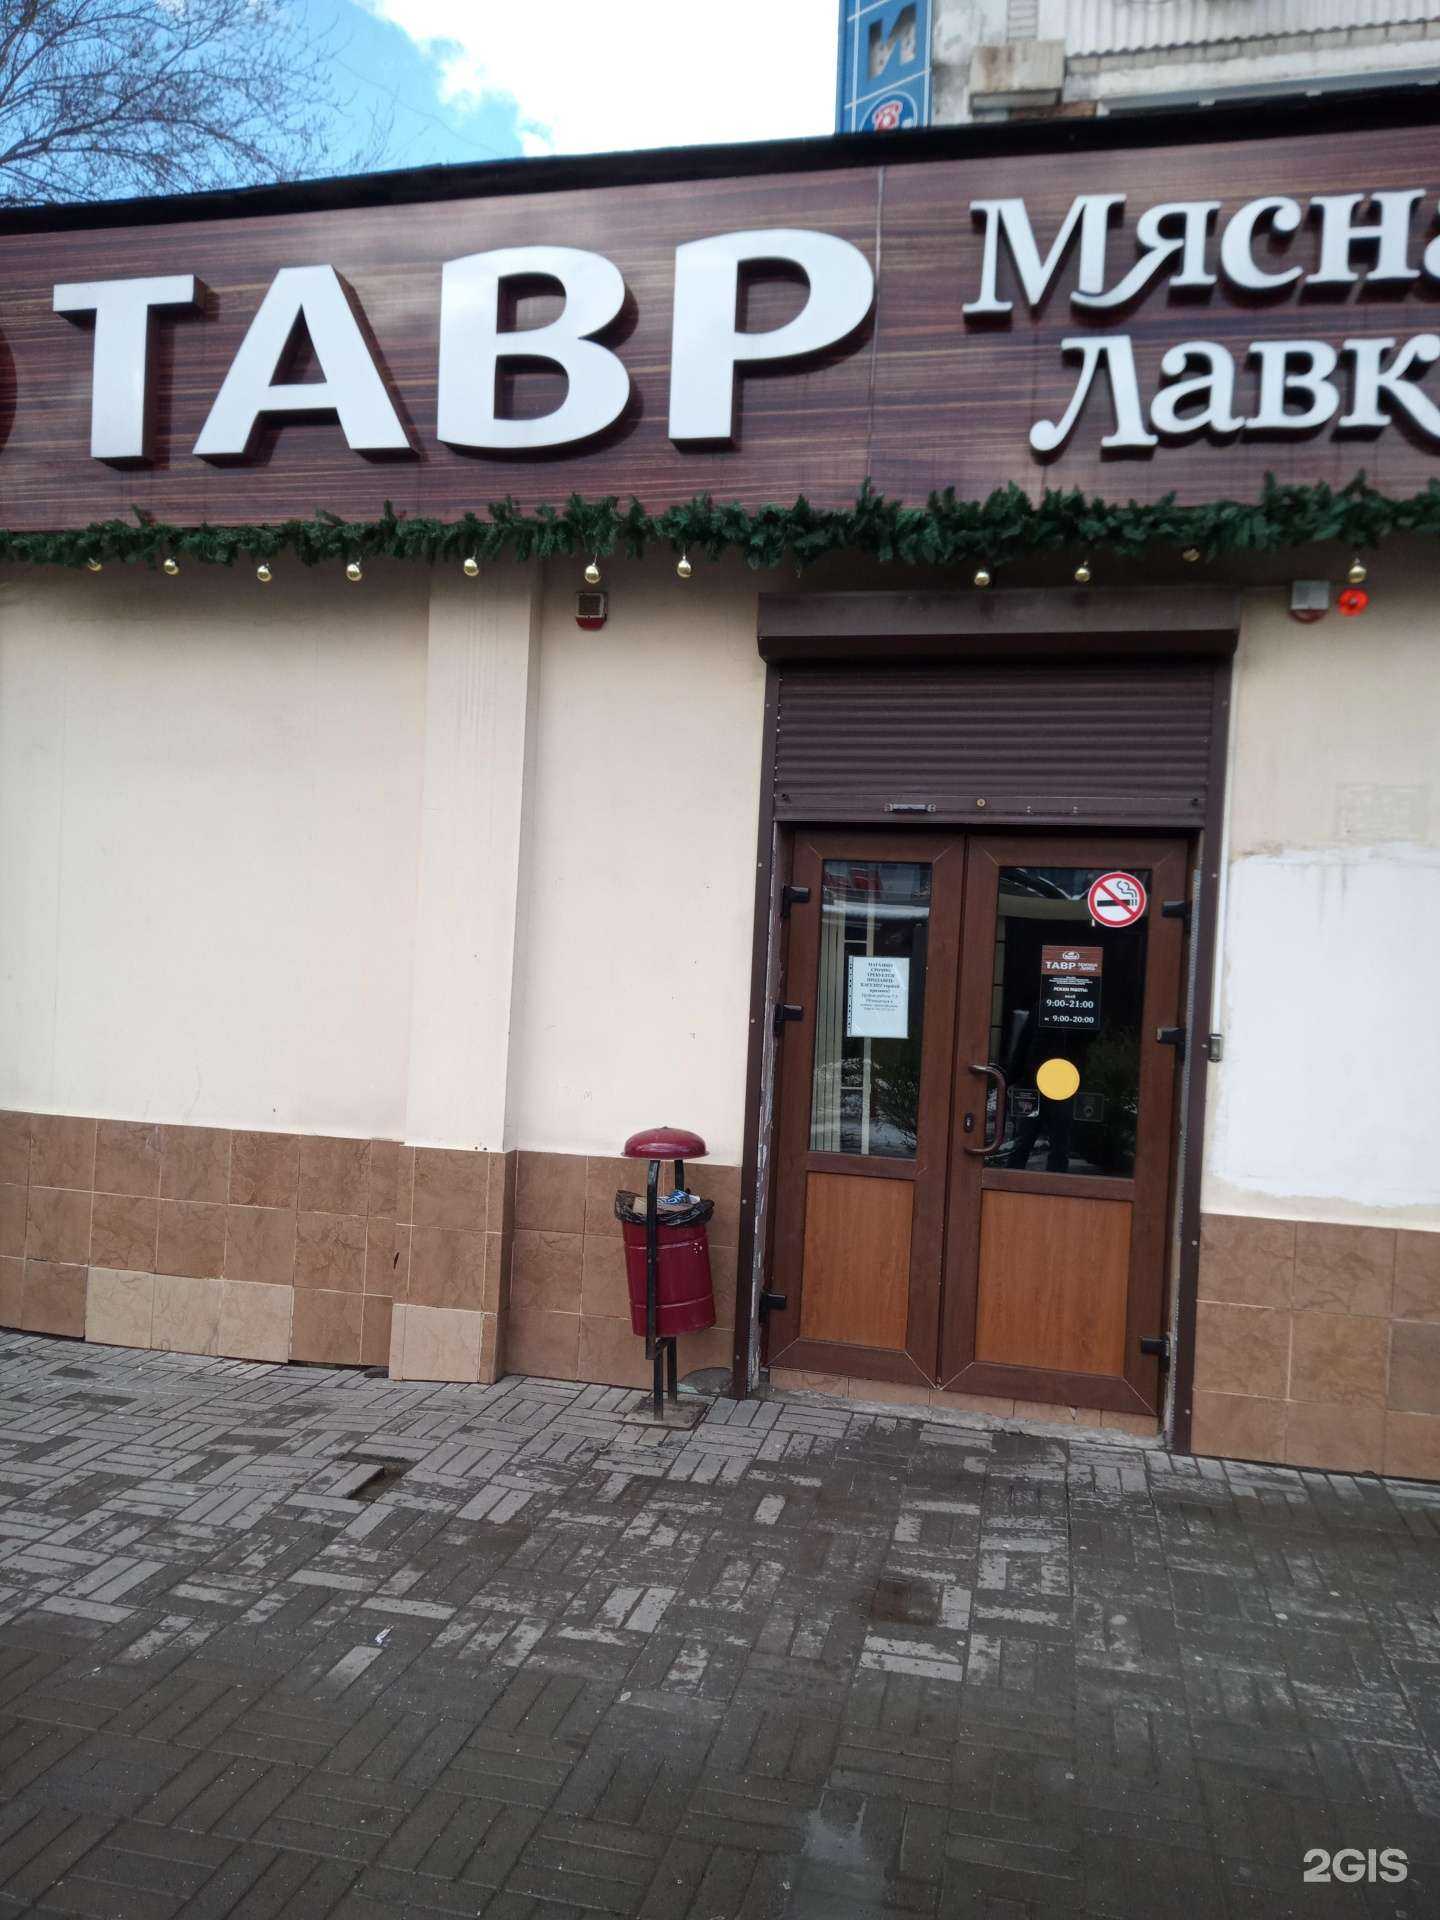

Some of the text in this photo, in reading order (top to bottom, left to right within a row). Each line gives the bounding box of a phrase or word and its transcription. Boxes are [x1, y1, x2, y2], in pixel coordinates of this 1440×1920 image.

[53, 228, 876, 461] ТАВР
[1045, 961, 1076, 970] ТАВР
[1046, 999, 1094, 1009] 9:00-21:00
[1052, 1014, 1095, 1024] 9:00-20:00
